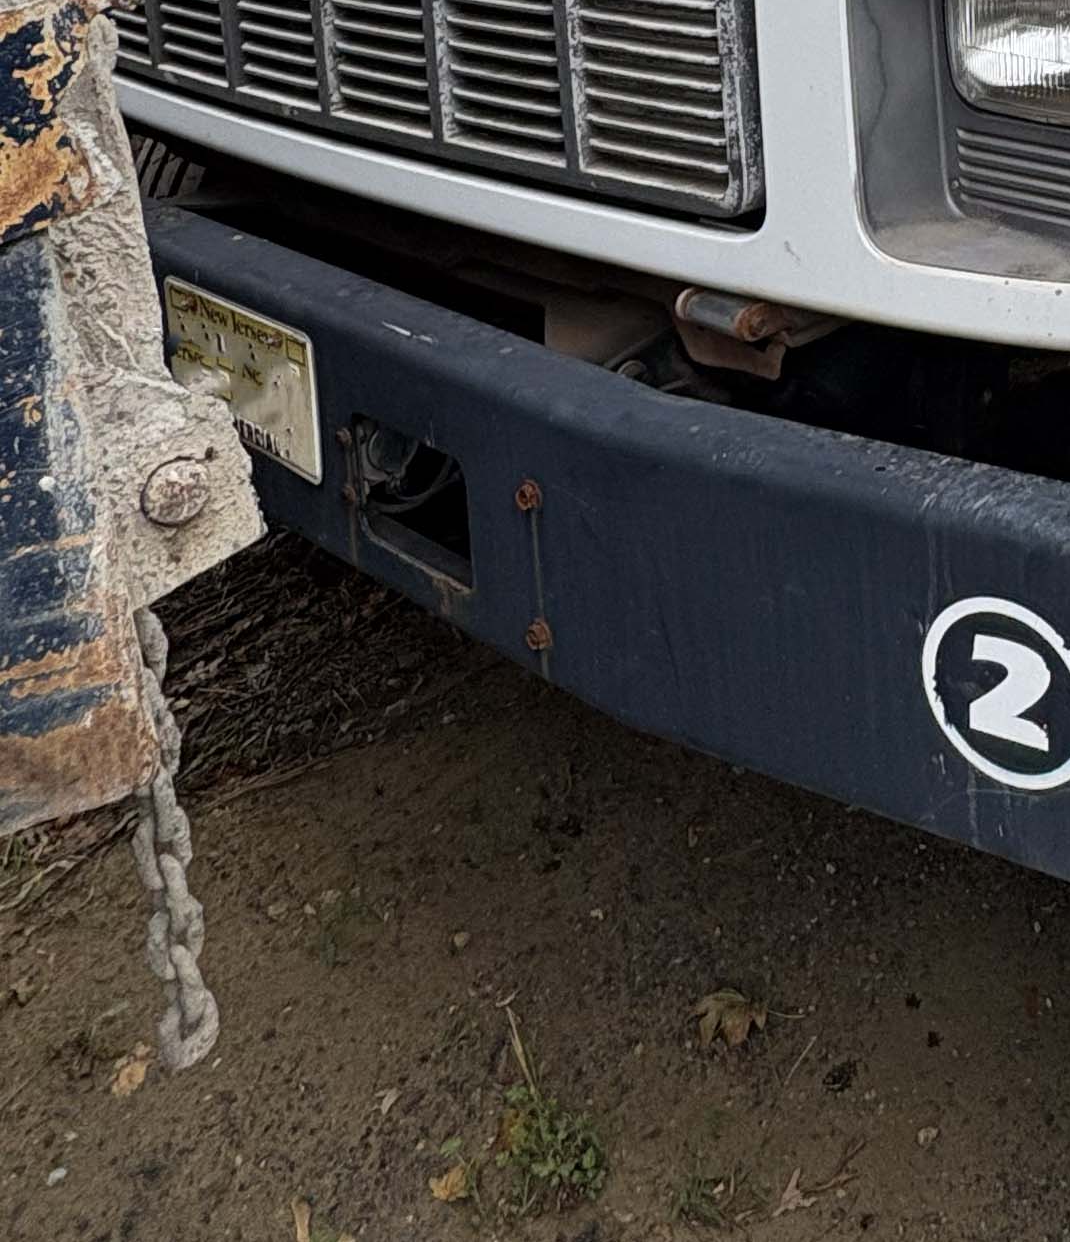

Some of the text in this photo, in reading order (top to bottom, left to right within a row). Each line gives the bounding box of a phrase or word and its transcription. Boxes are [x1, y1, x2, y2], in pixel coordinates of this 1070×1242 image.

[199, 296, 271, 348] New Jersey
[968, 633, 1051, 753] 2
